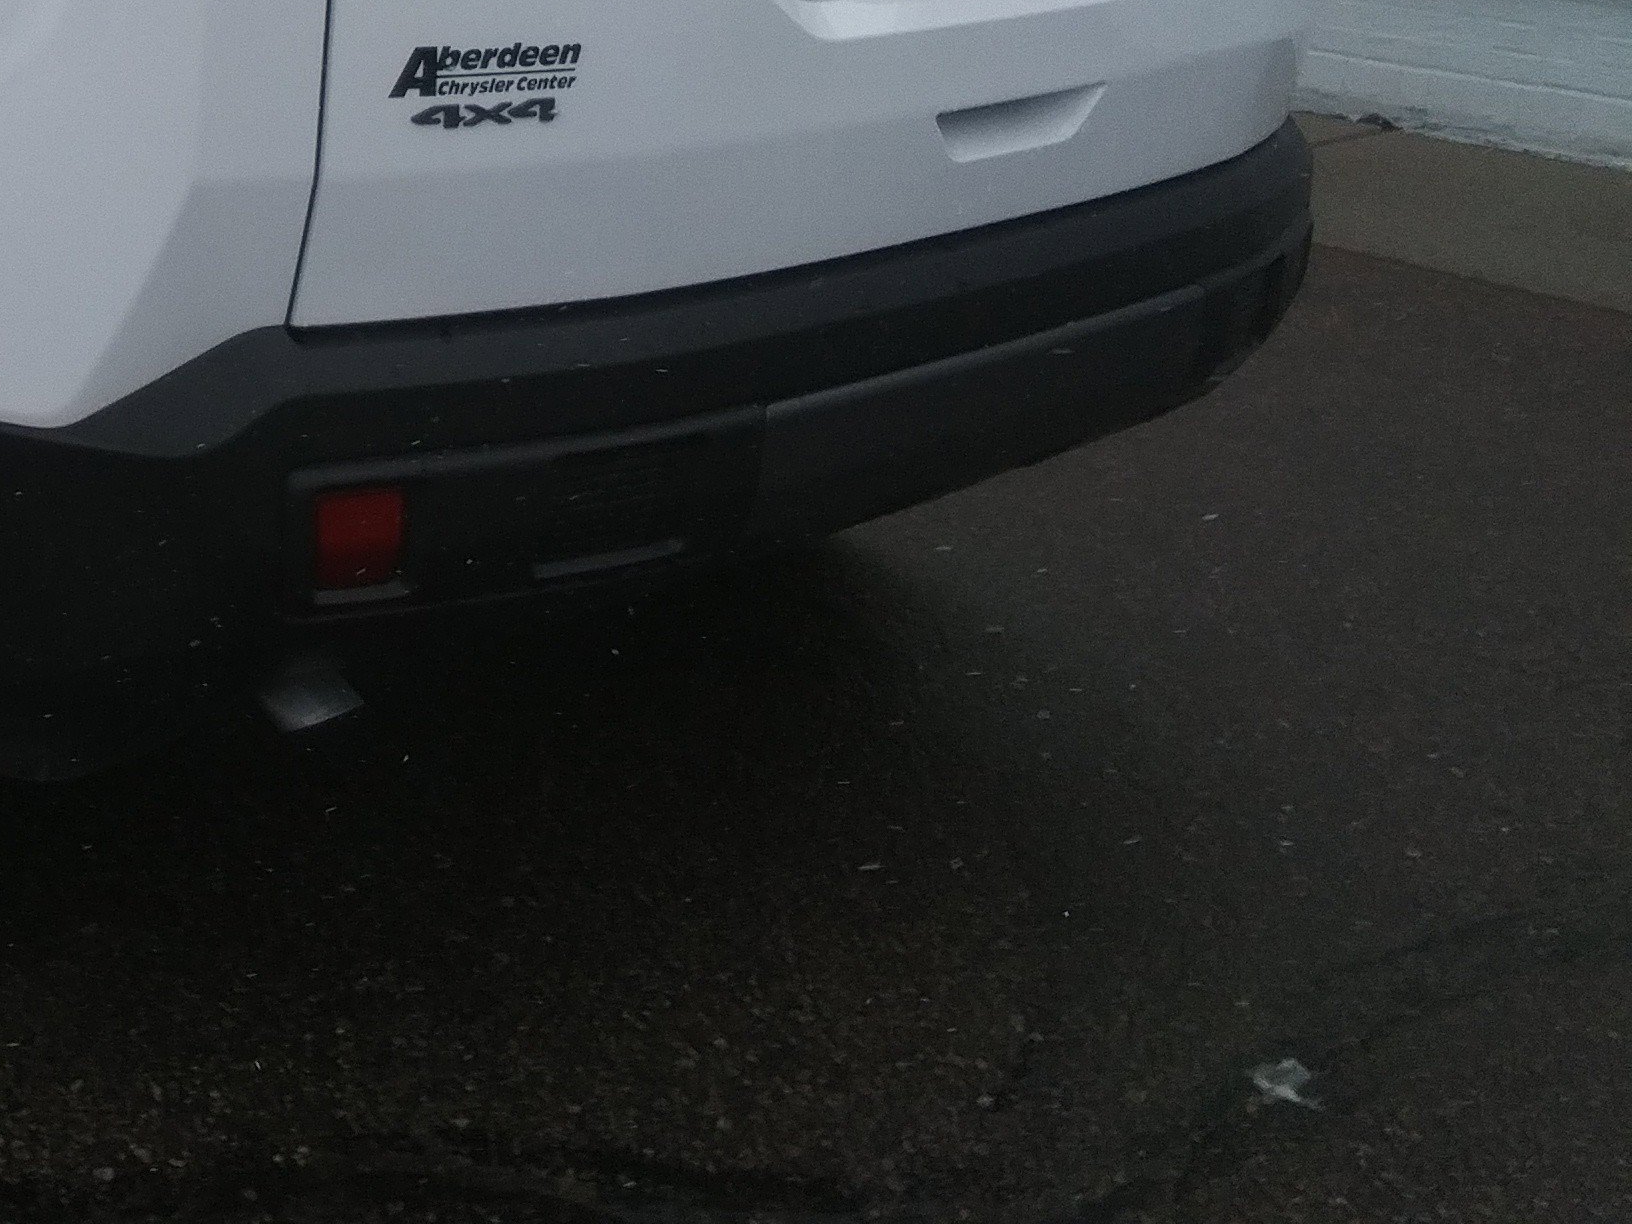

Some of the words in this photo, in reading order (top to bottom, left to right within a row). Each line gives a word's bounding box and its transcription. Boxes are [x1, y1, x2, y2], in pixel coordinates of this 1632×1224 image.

[387, 41, 582, 99] Aberdeen
[437, 77, 515, 97] Chrysler
[516, 75, 578, 92] Center
